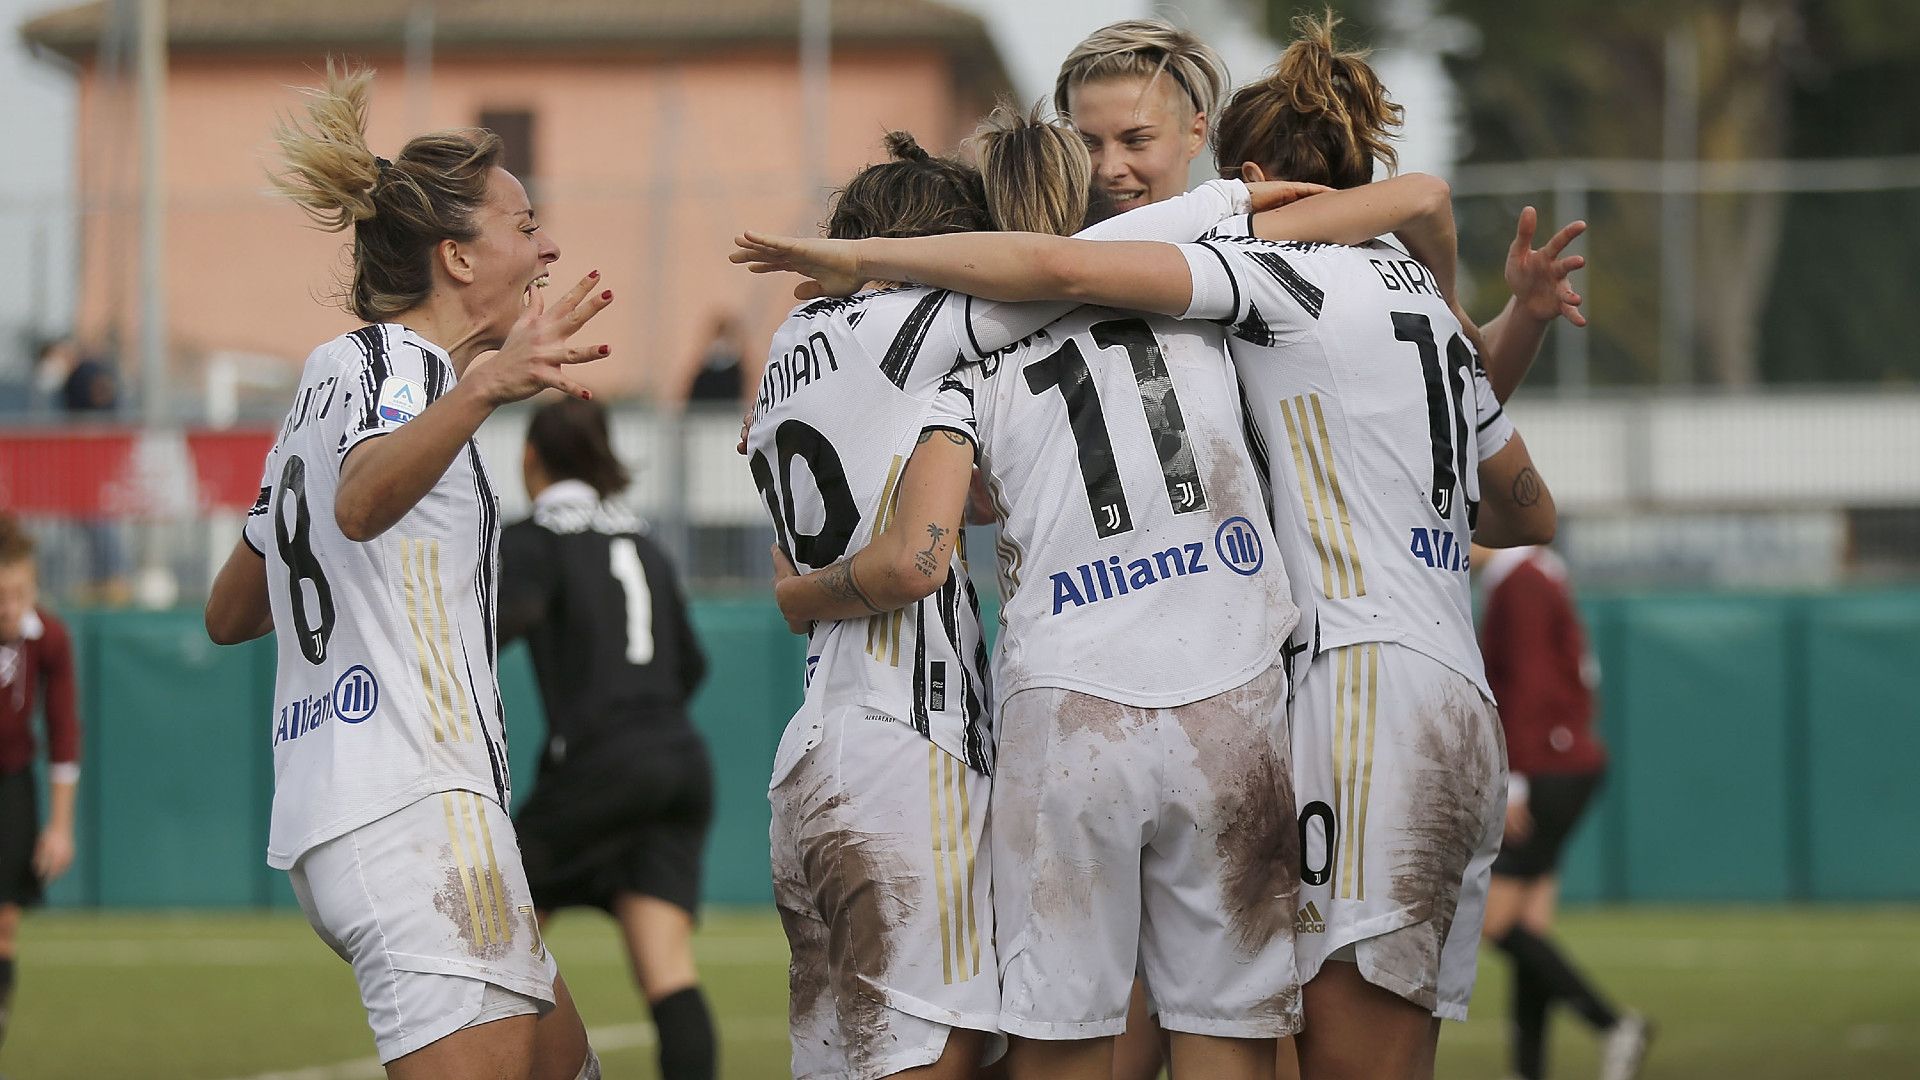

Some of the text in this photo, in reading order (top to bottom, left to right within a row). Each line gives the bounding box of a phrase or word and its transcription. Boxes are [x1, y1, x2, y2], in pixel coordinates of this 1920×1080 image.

[1022, 318, 1209, 540] 11
[275, 454, 336, 666] 8
[609, 537, 654, 665] 1
[1049, 542, 1209, 616] Allianz
